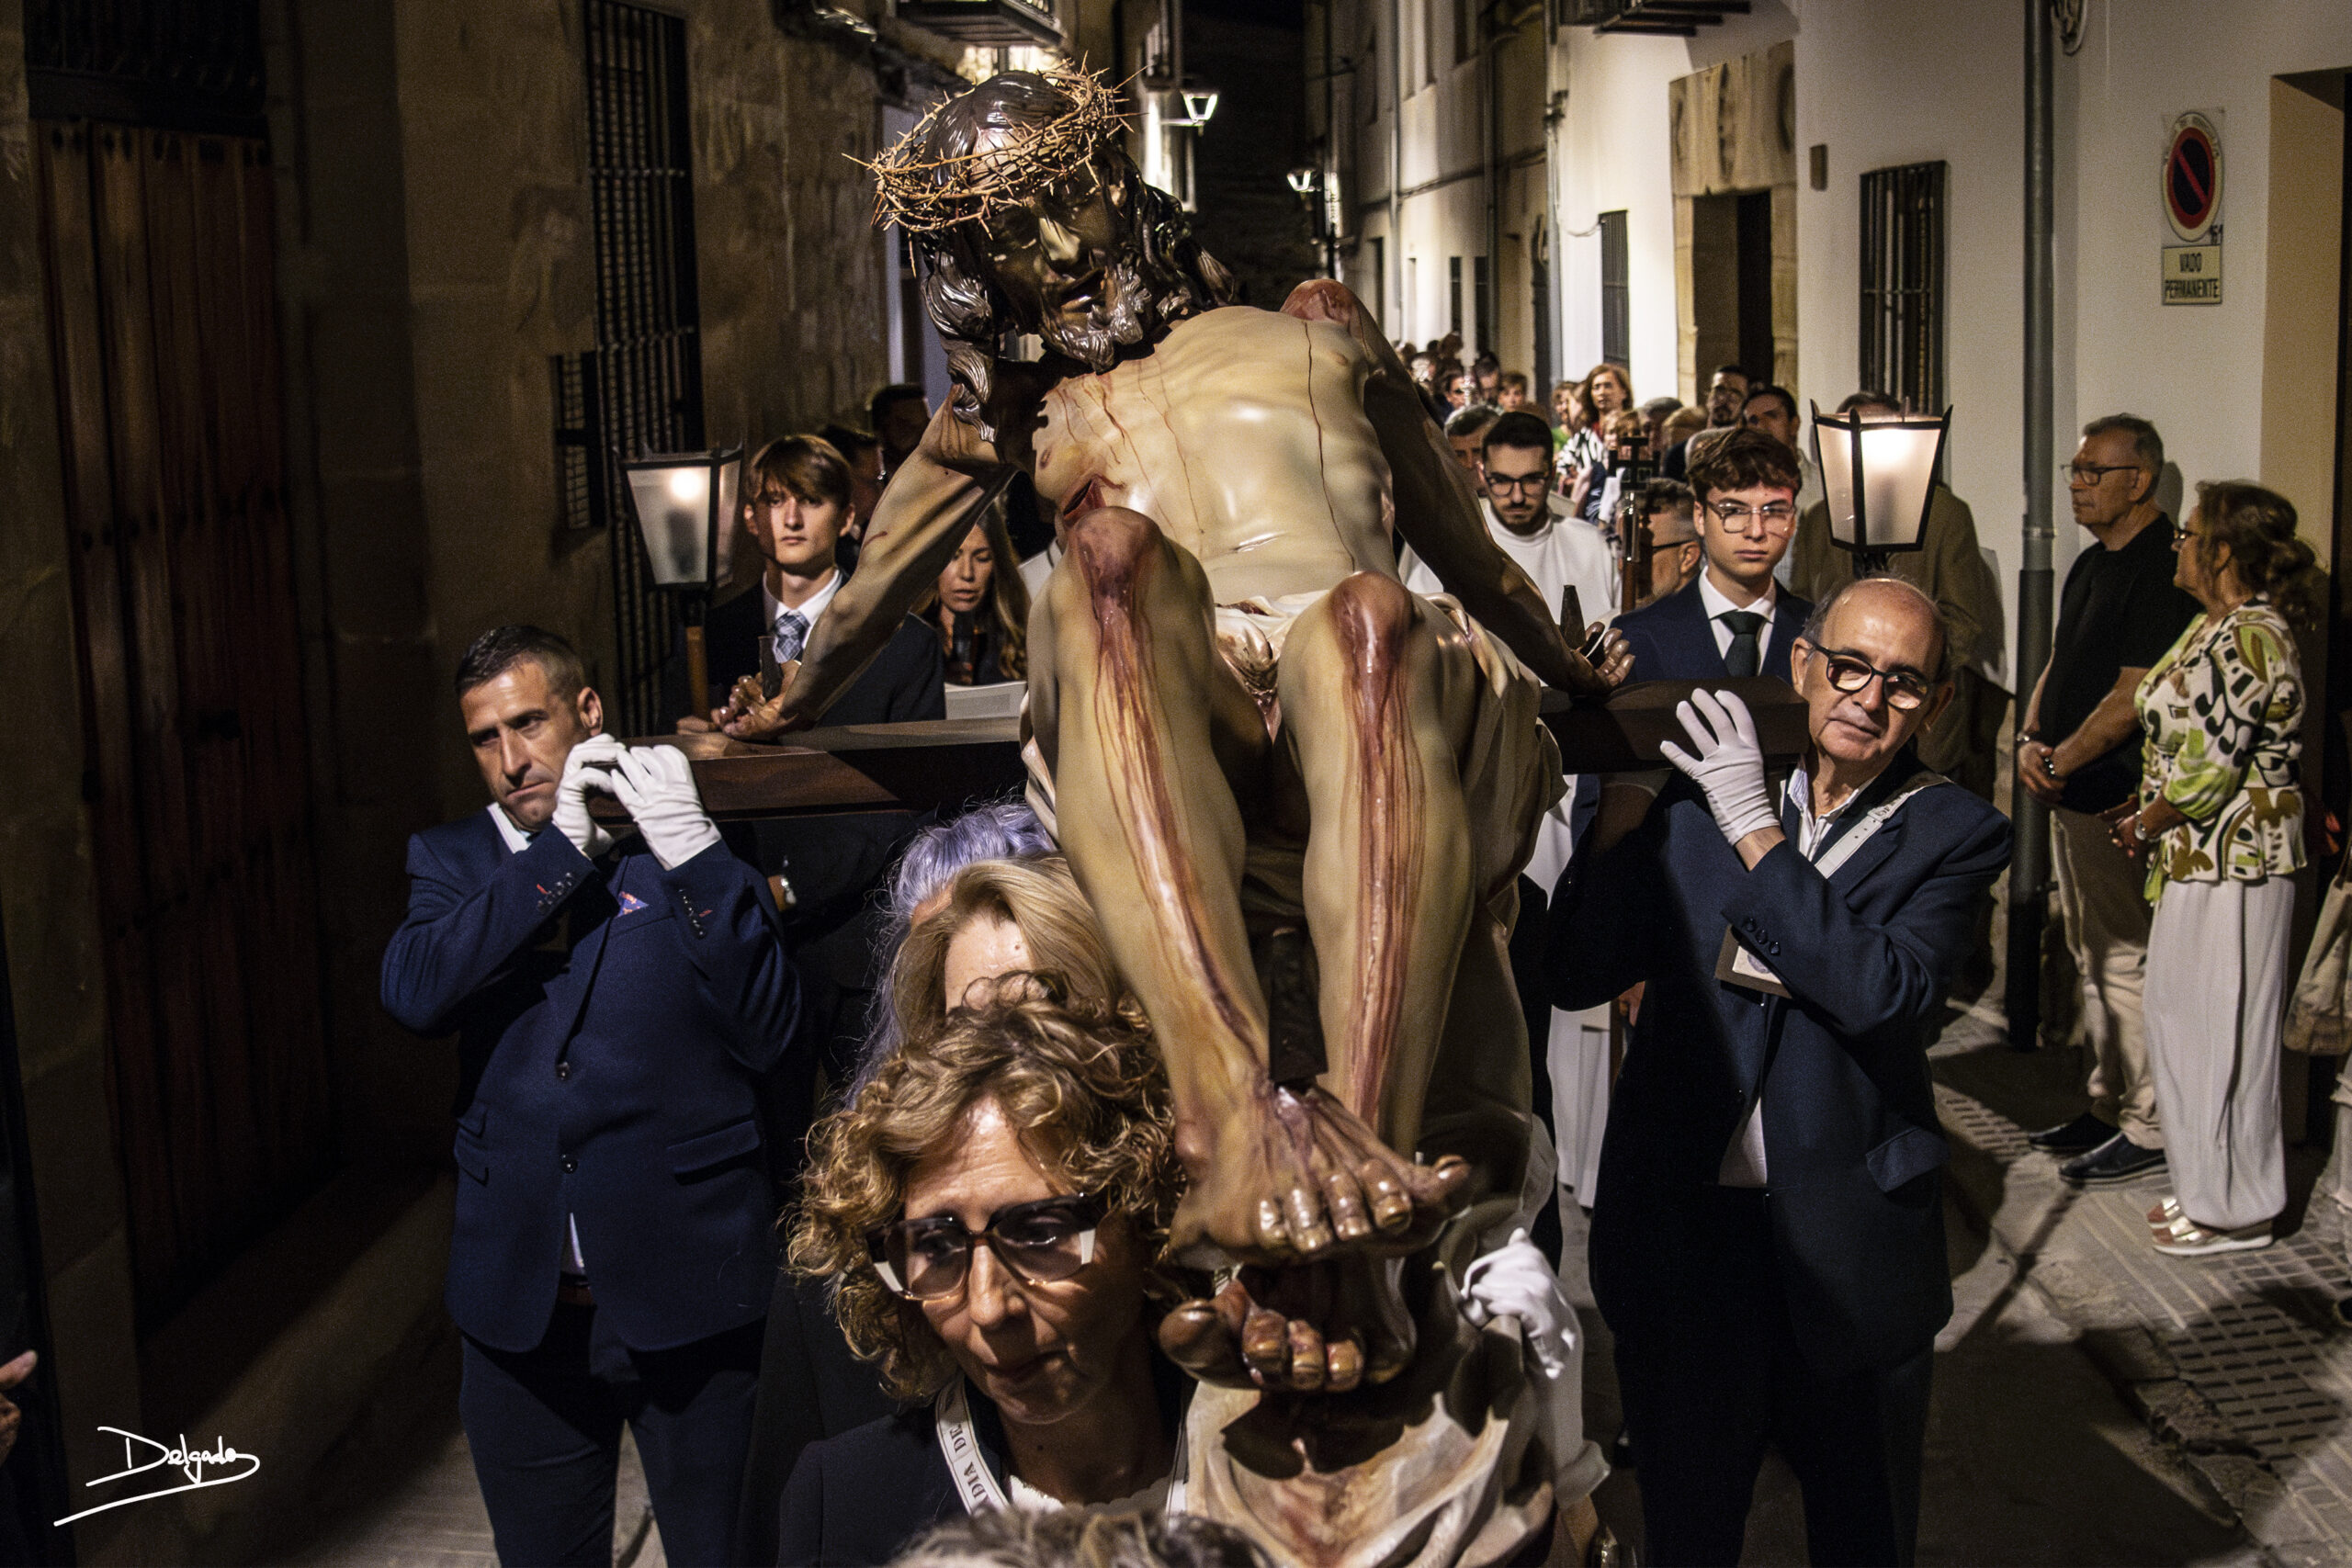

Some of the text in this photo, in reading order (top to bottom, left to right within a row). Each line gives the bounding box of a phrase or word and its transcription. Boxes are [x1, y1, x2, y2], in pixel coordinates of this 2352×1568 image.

[2179, 253, 2202, 273] VADO
[2165, 279, 2219, 299] PERMANENTE
[949, 1423, 967, 1452] DE
